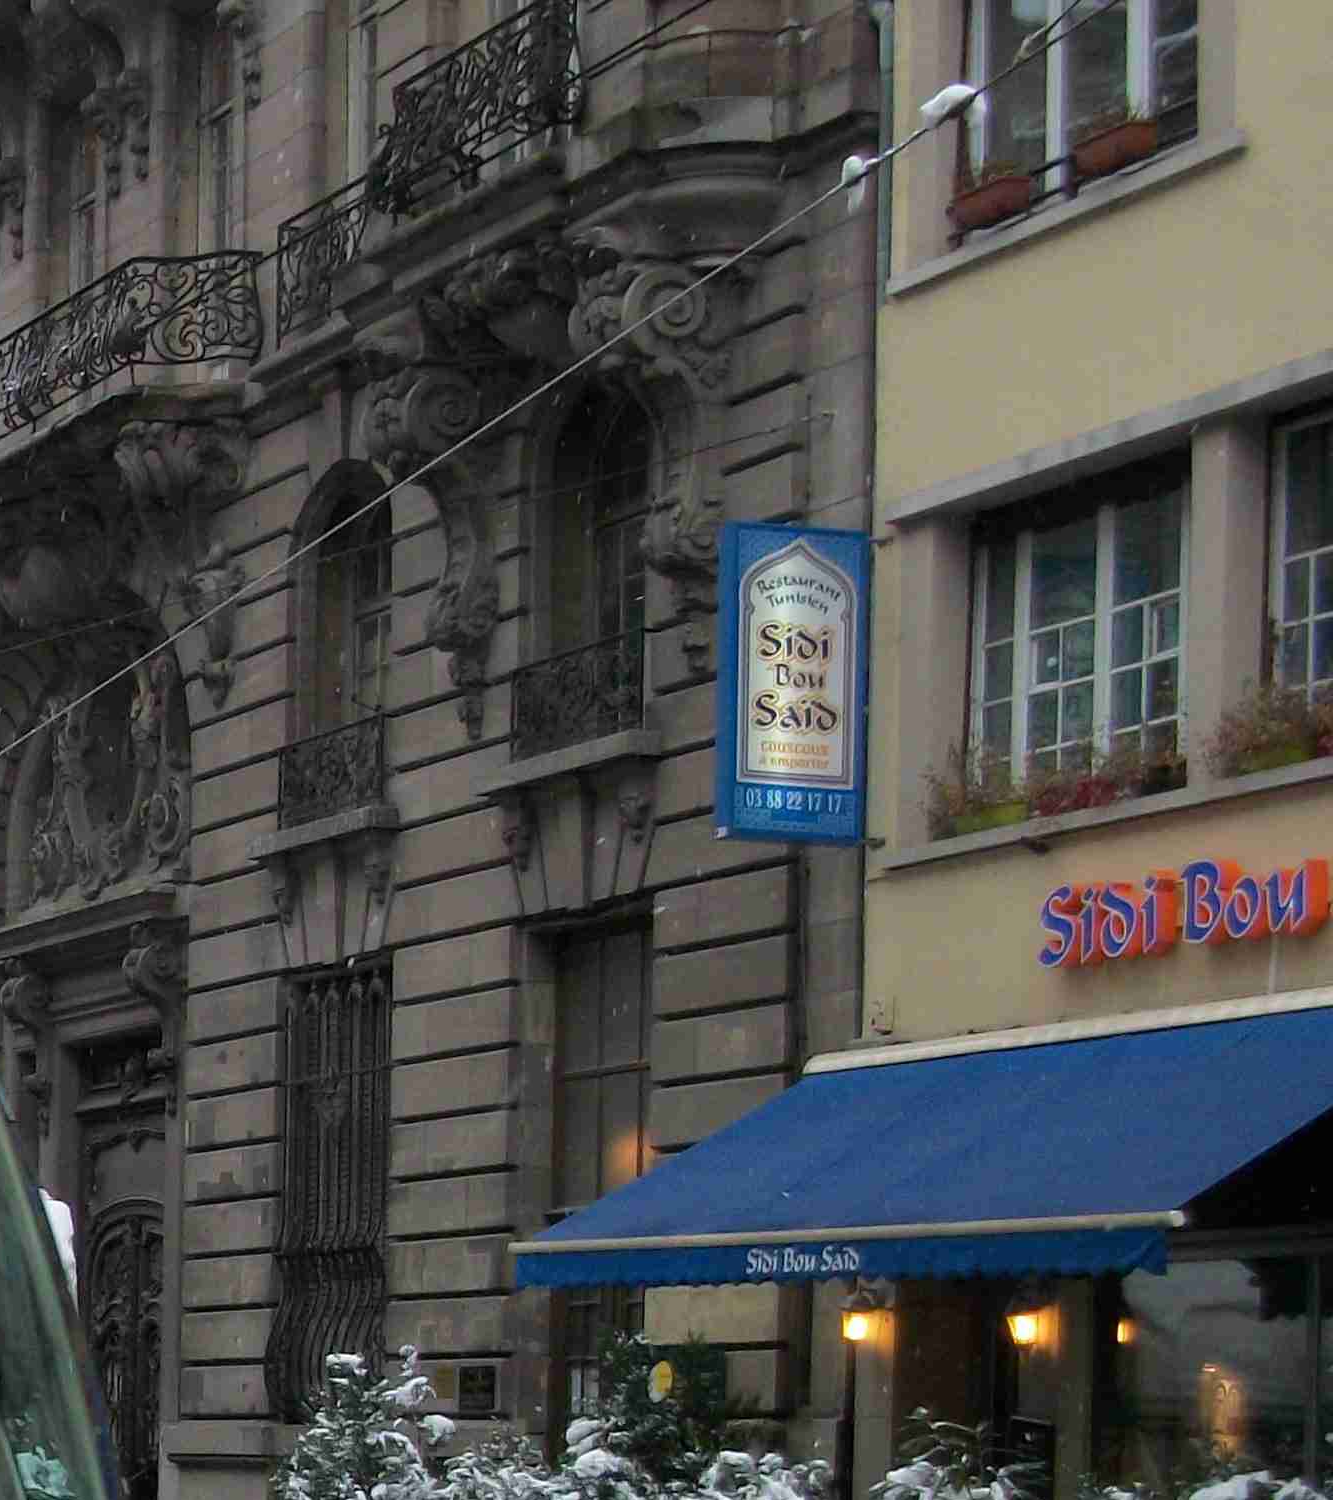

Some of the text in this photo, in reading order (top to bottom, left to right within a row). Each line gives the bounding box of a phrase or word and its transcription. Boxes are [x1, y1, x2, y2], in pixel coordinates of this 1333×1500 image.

[756, 575, 842, 603] Restaurant
[765, 591, 830, 615] Tunisien
[758, 622, 830, 661] Sidi
[775, 662, 825, 689] Bou
[745, 787, 843, 814] 03 88 22 17 17
[1038, 857, 1307, 968] Sidi Bou
[745, 1247, 779, 1275] Sidi
[782, 1246, 816, 1273] Bou
